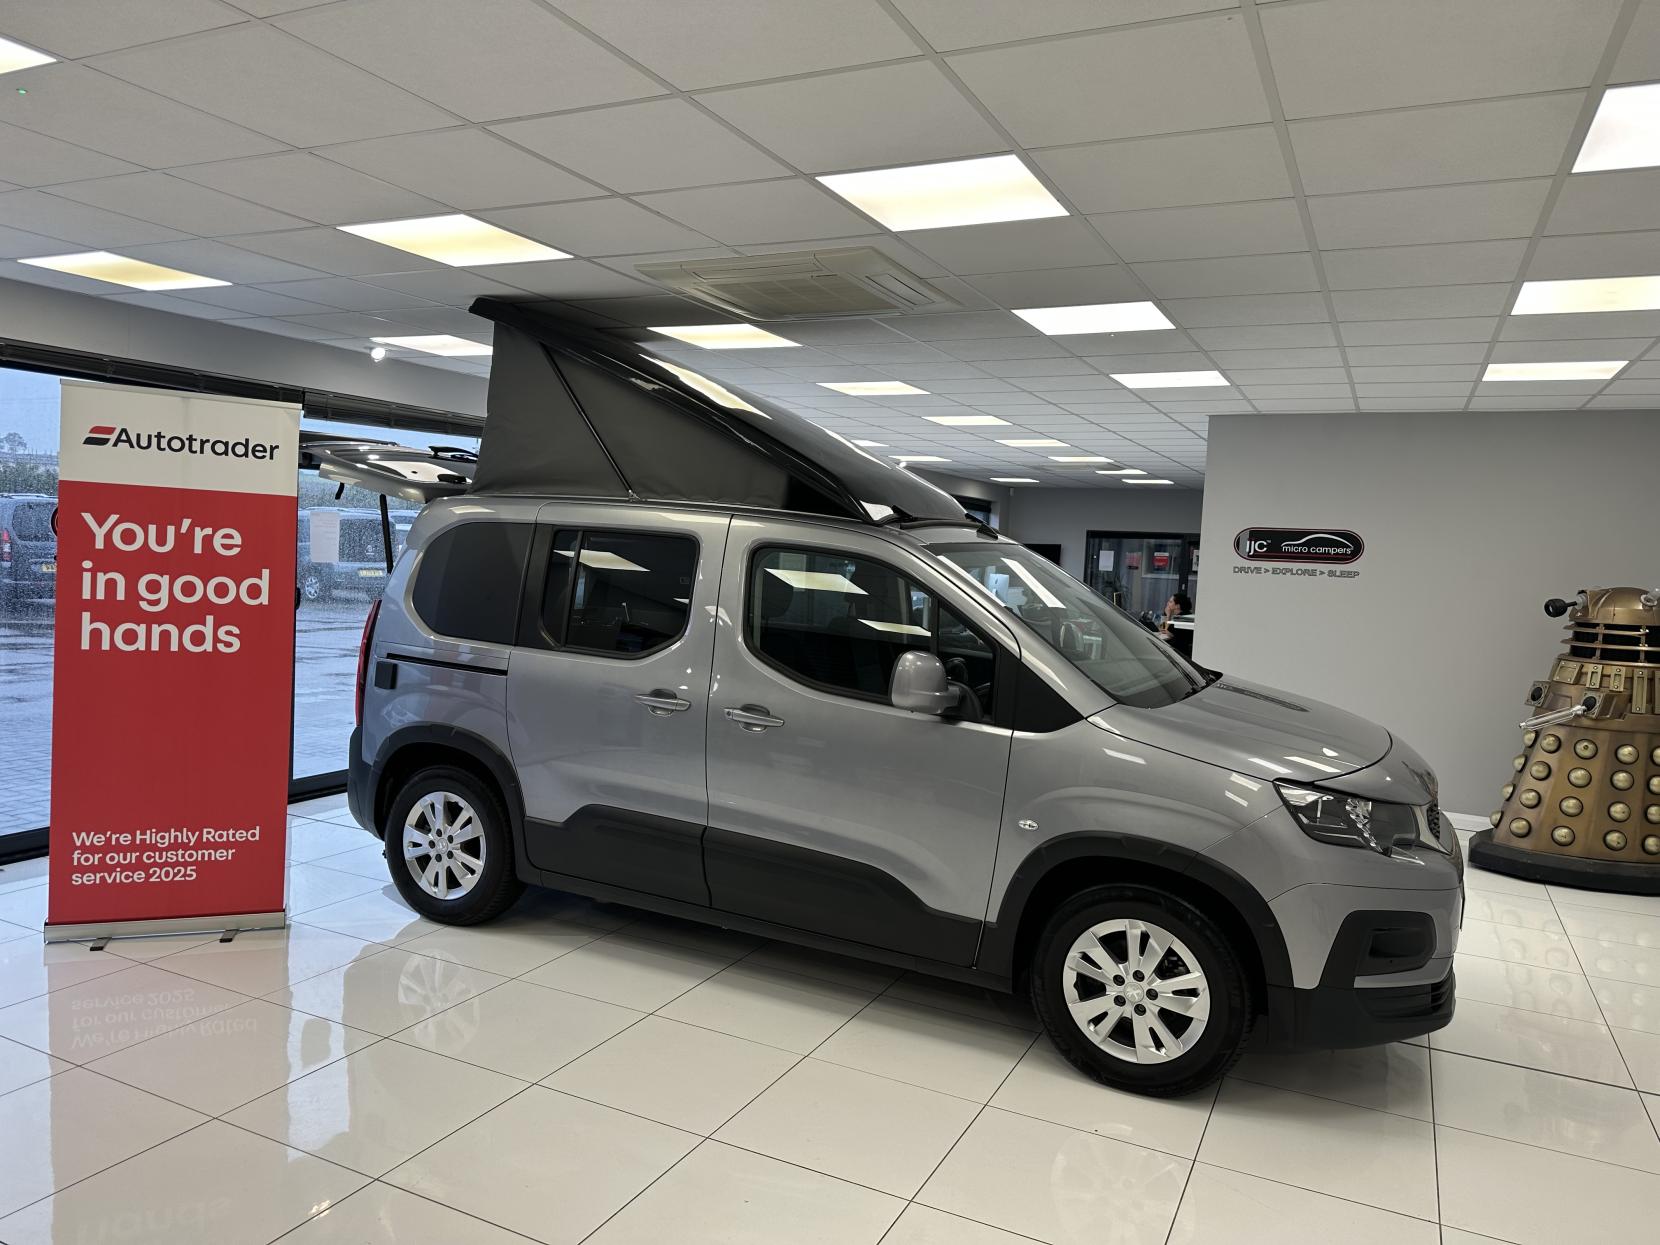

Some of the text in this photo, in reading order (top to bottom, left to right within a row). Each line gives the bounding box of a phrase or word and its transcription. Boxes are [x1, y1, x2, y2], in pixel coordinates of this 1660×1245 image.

[112, 427, 279, 460] Autotrader
[81, 512, 242, 556] You're
[1282, 545, 1351, 555] micro campers
[1233, 566, 1262, 574] DRIVE
[1272, 567, 1317, 577] EXPLORE
[1327, 570, 1360, 579] SLEEP
[82, 560, 270, 612] in good
[80, 612, 241, 653] hands
[72, 826, 260, 848] We're Highly Rated
[72, 847, 236, 866] for our customer
[71, 866, 197, 885] service 2025
